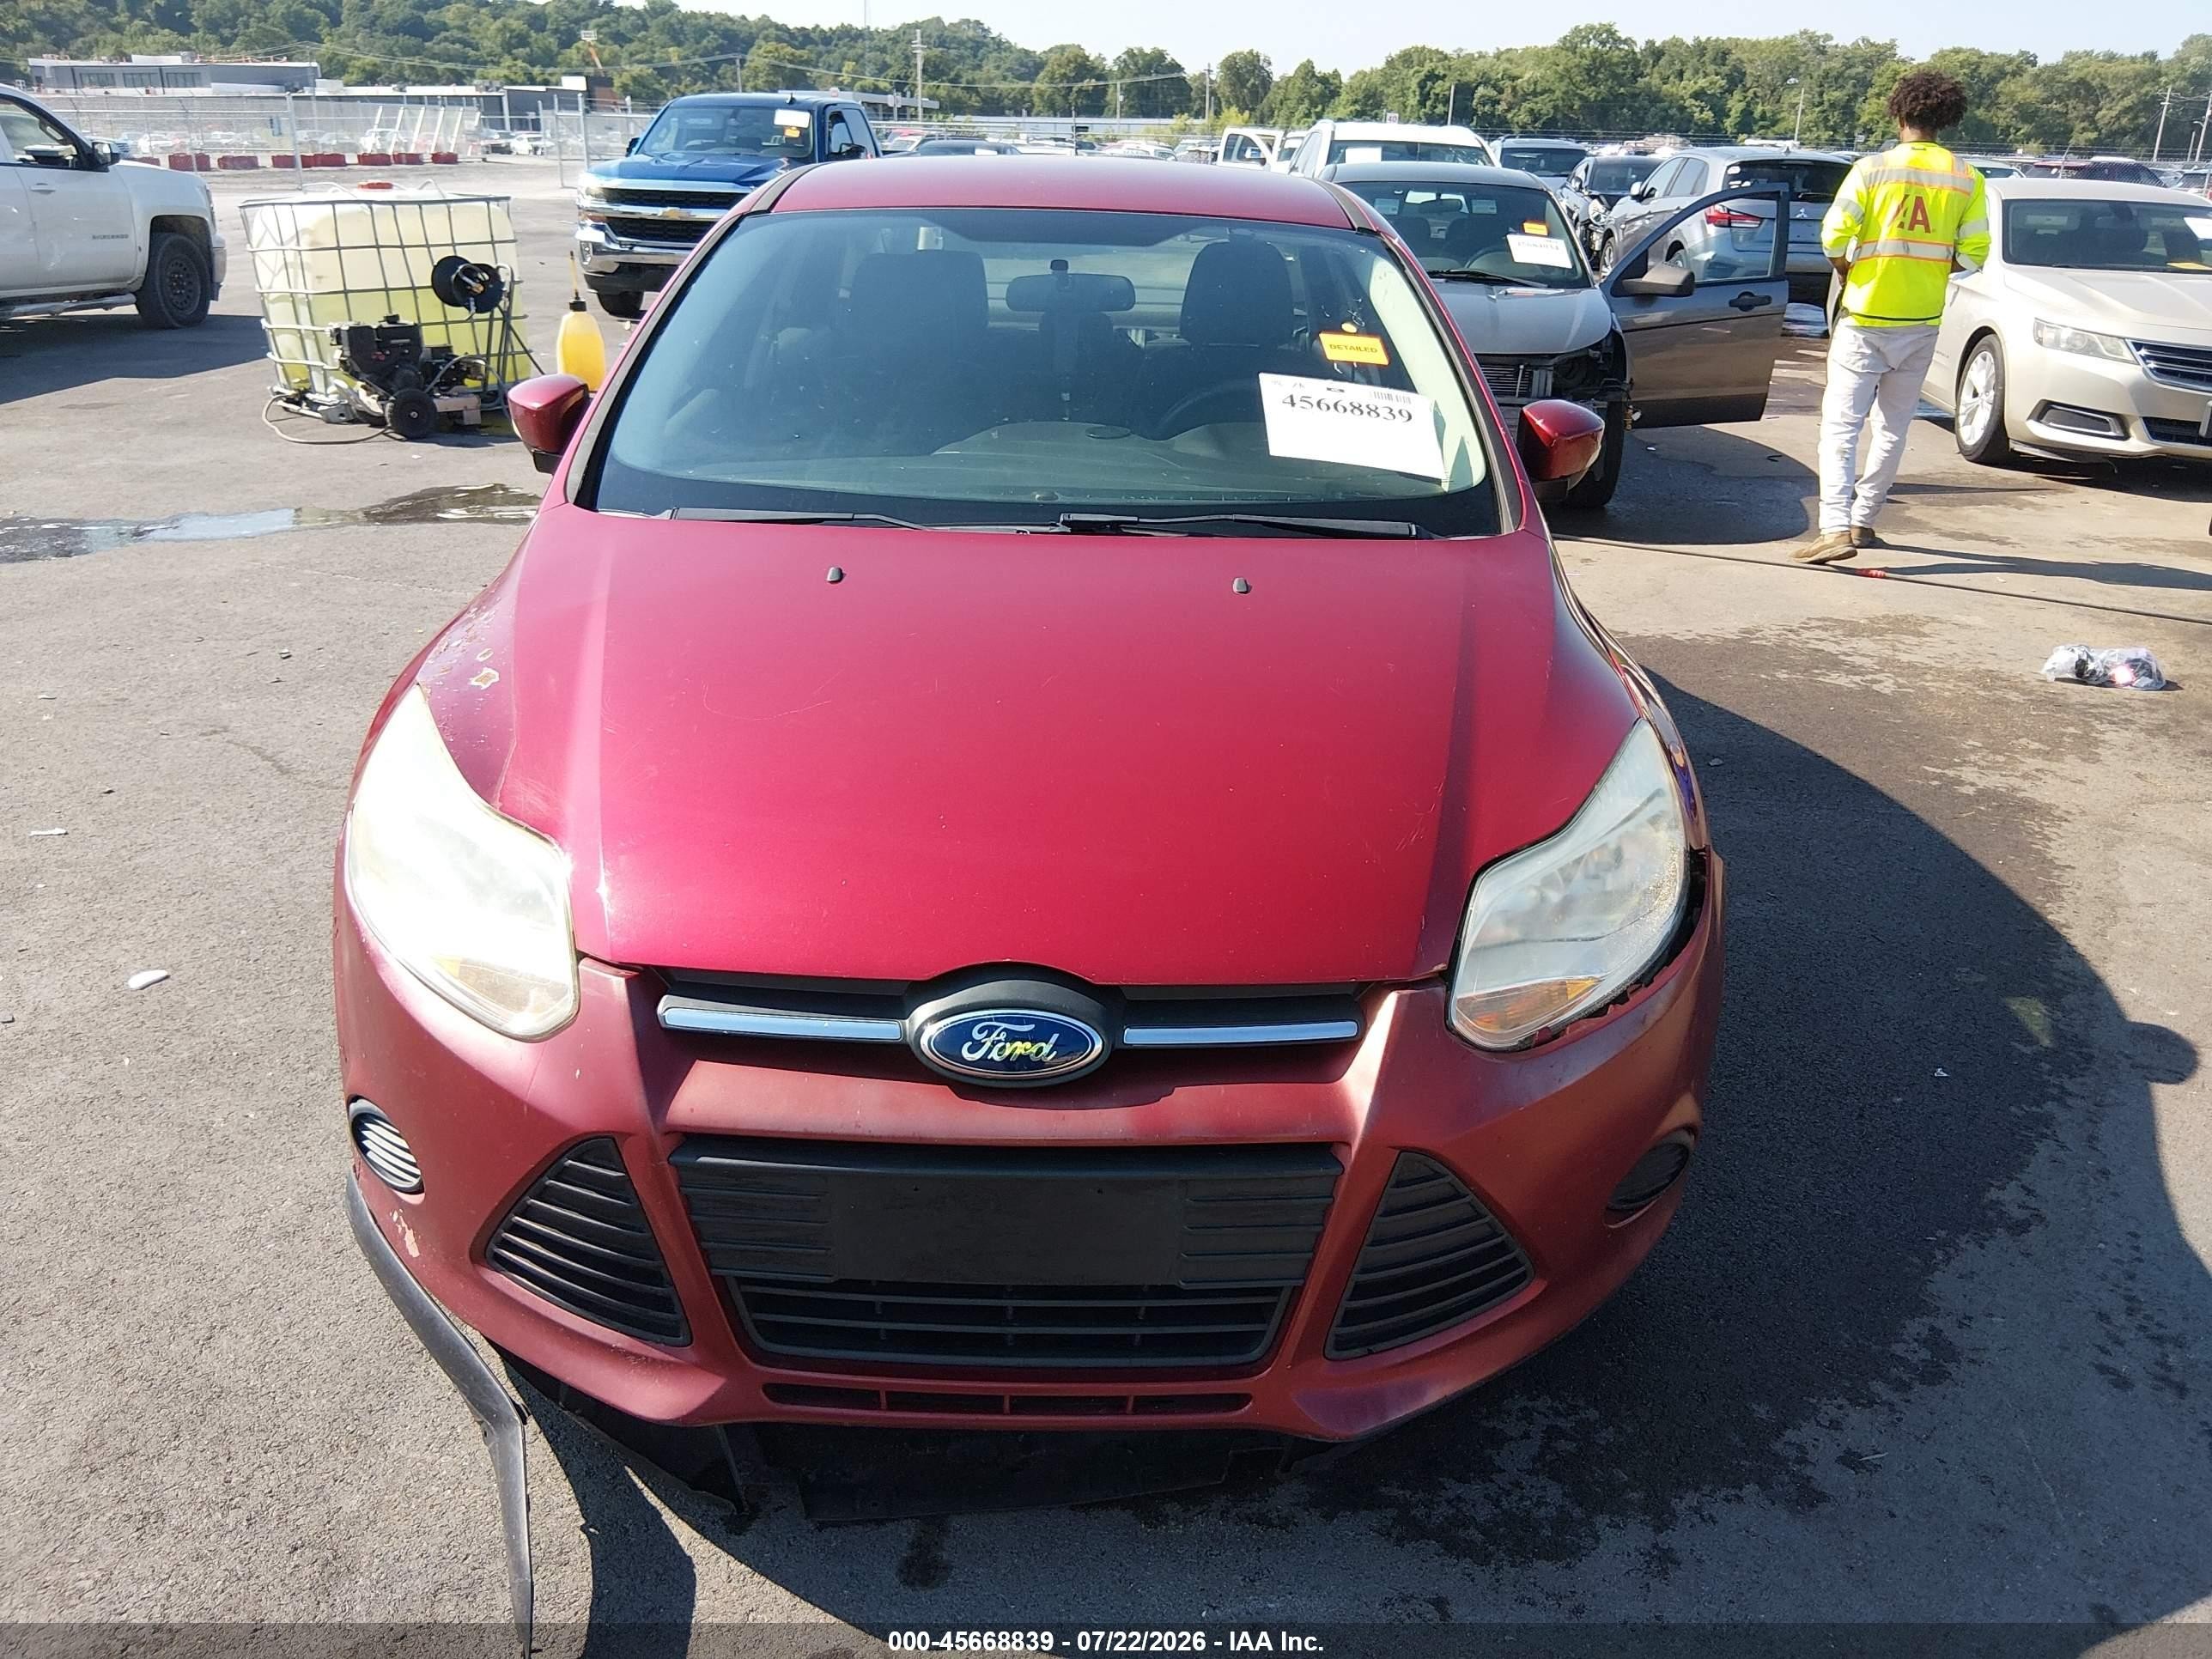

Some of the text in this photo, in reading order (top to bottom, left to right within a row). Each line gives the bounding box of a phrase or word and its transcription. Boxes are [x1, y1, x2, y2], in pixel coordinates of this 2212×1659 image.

[1329, 343, 1378, 354] DETAILED
[1281, 392, 1413, 423] 45668839
[961, 1020, 1060, 1062] Ford
